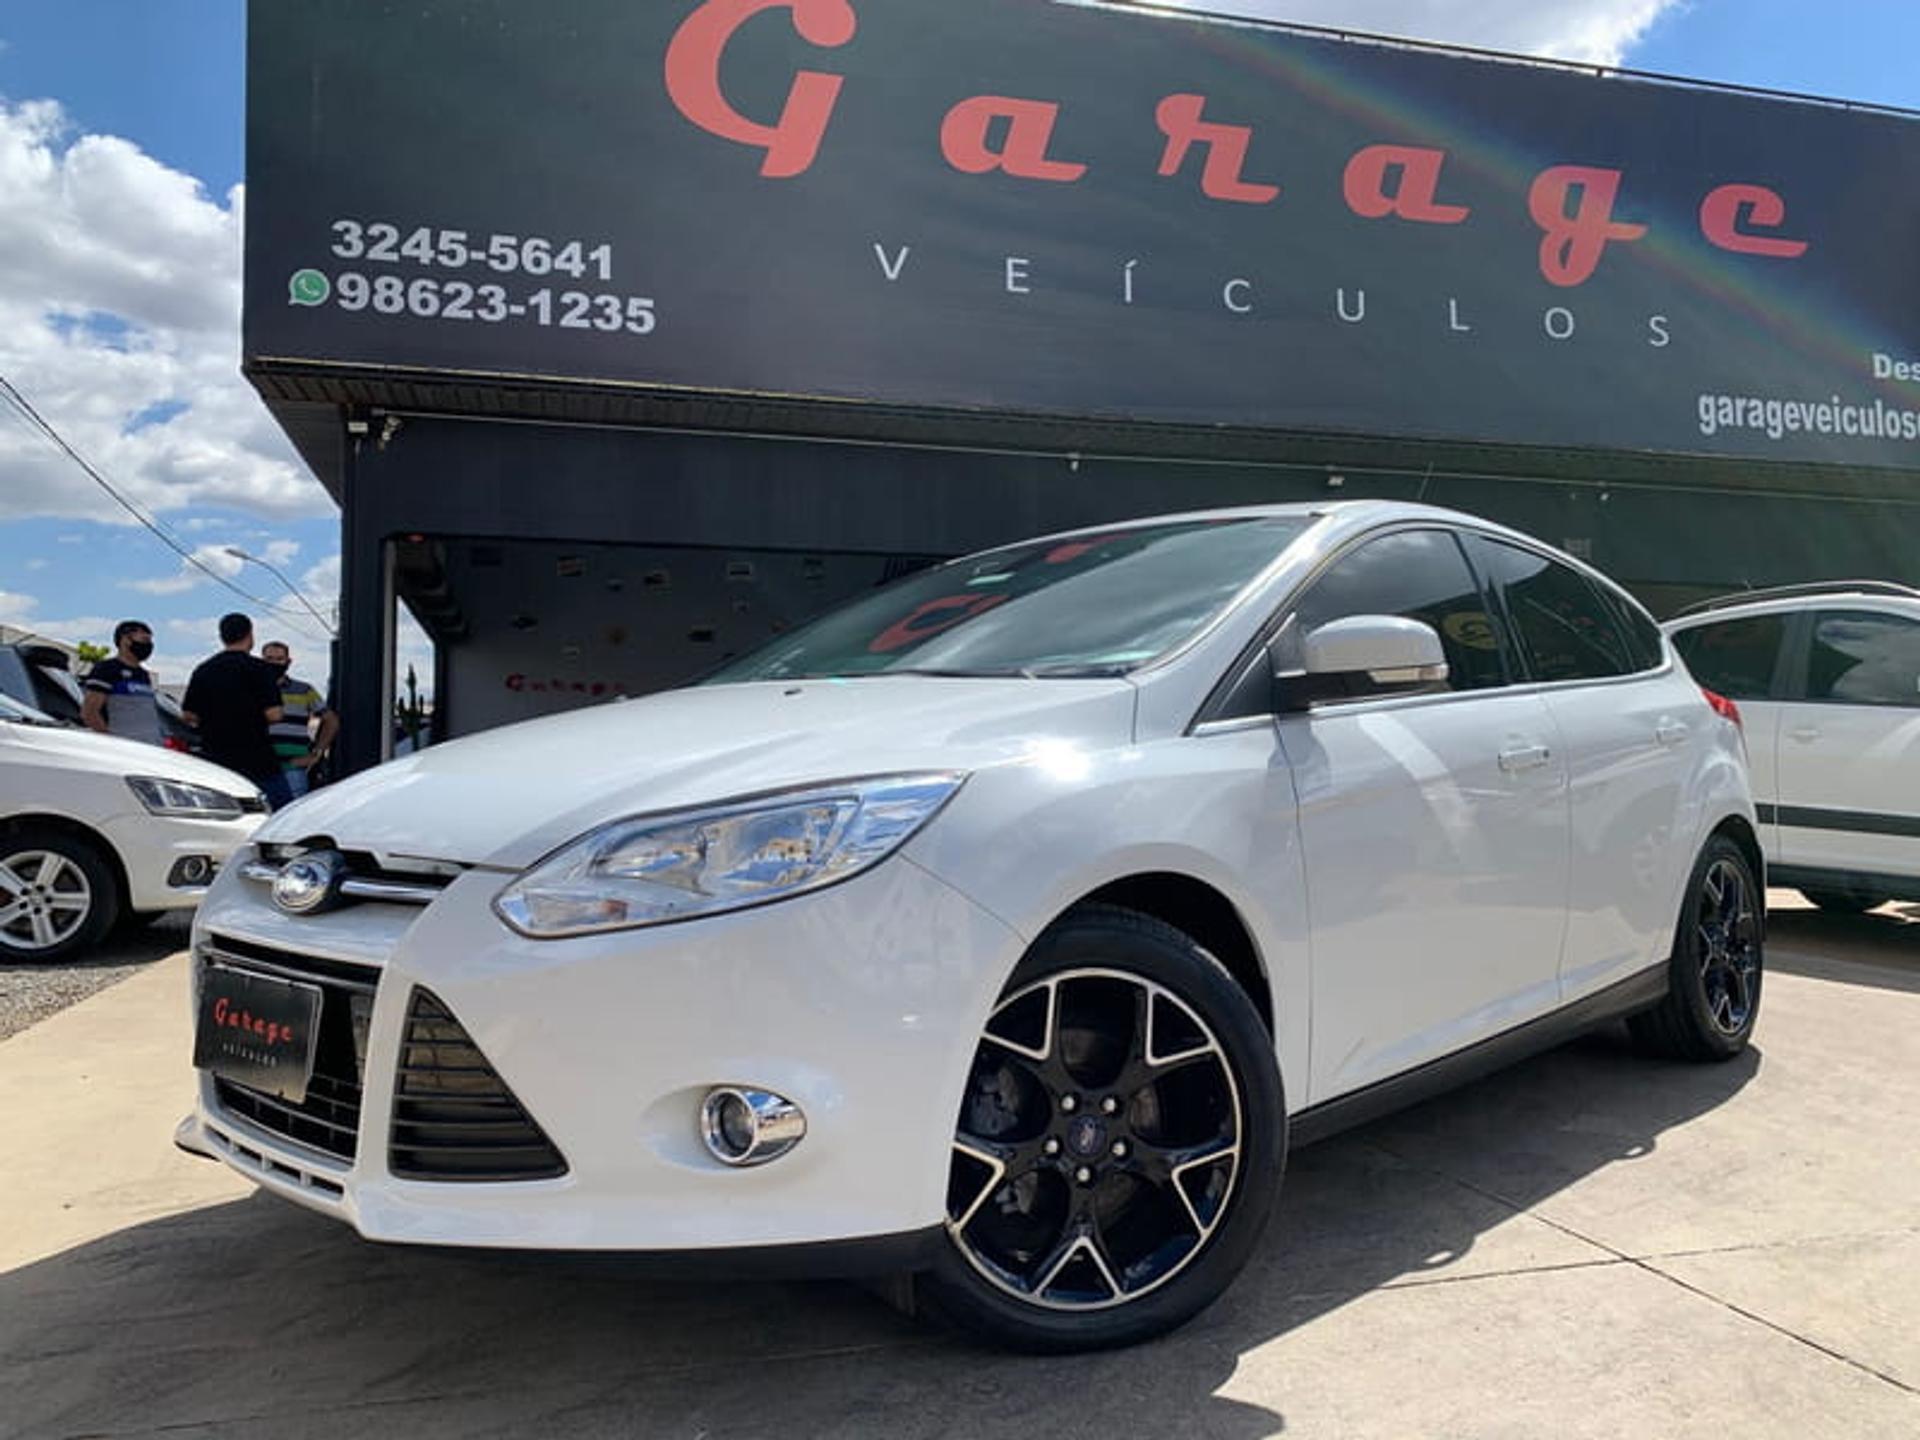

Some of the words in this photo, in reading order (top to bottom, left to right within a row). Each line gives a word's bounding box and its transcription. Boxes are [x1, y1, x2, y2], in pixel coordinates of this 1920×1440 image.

[664, 0, 1808, 286] Garage
[331, 220, 613, 281] 3245-5641
[336, 272, 656, 334] 98623-1235
[874, 243, 1670, 346] VEÍCULOS
[1698, 394, 1920, 439] garageveiculos
